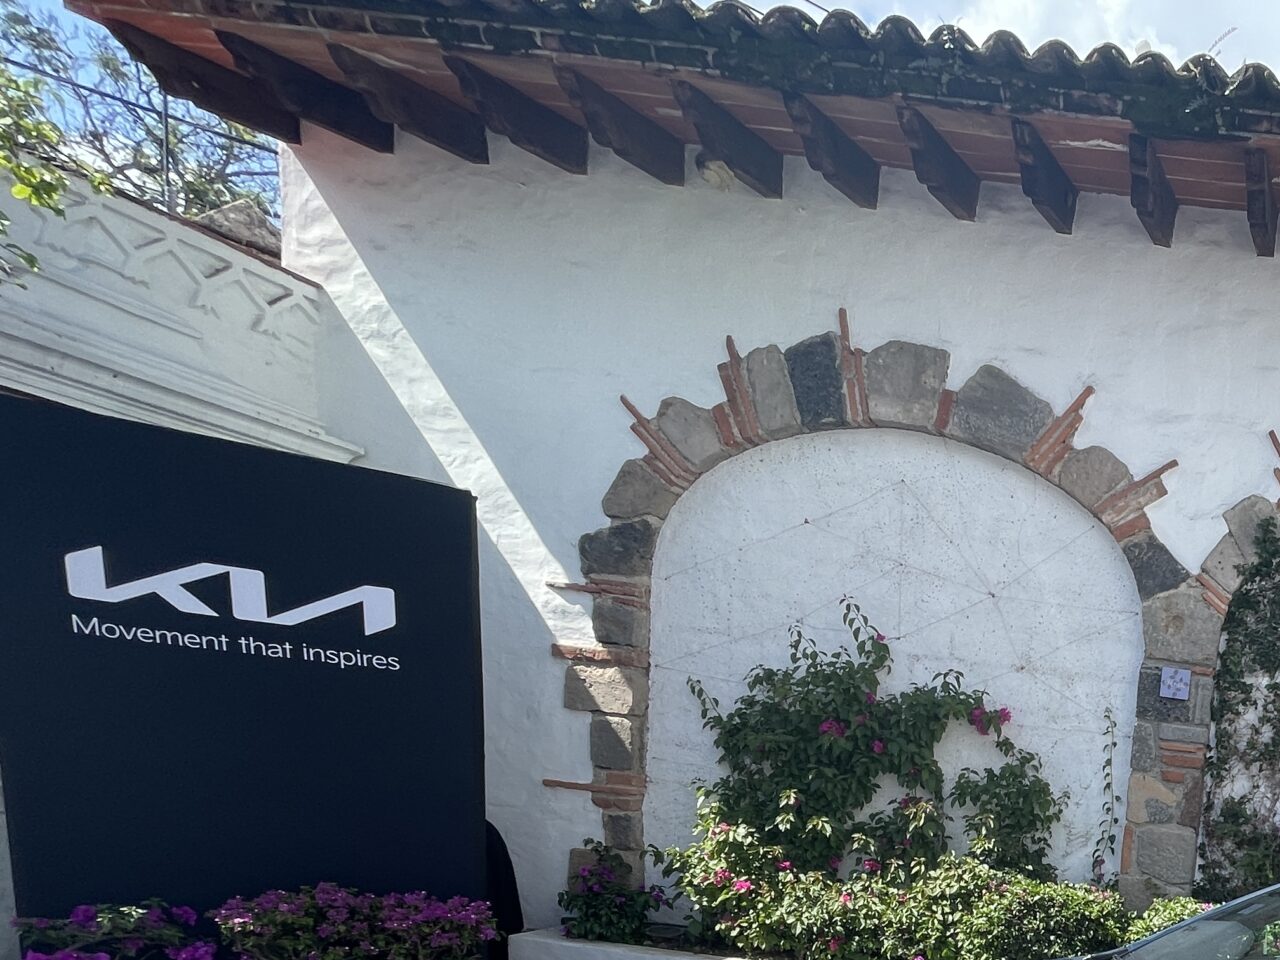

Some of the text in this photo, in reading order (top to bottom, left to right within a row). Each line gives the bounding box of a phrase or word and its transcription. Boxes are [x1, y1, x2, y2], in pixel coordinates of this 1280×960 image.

[64, 545, 396, 635] KIA
[71, 613, 400, 670] Movement that inspires
